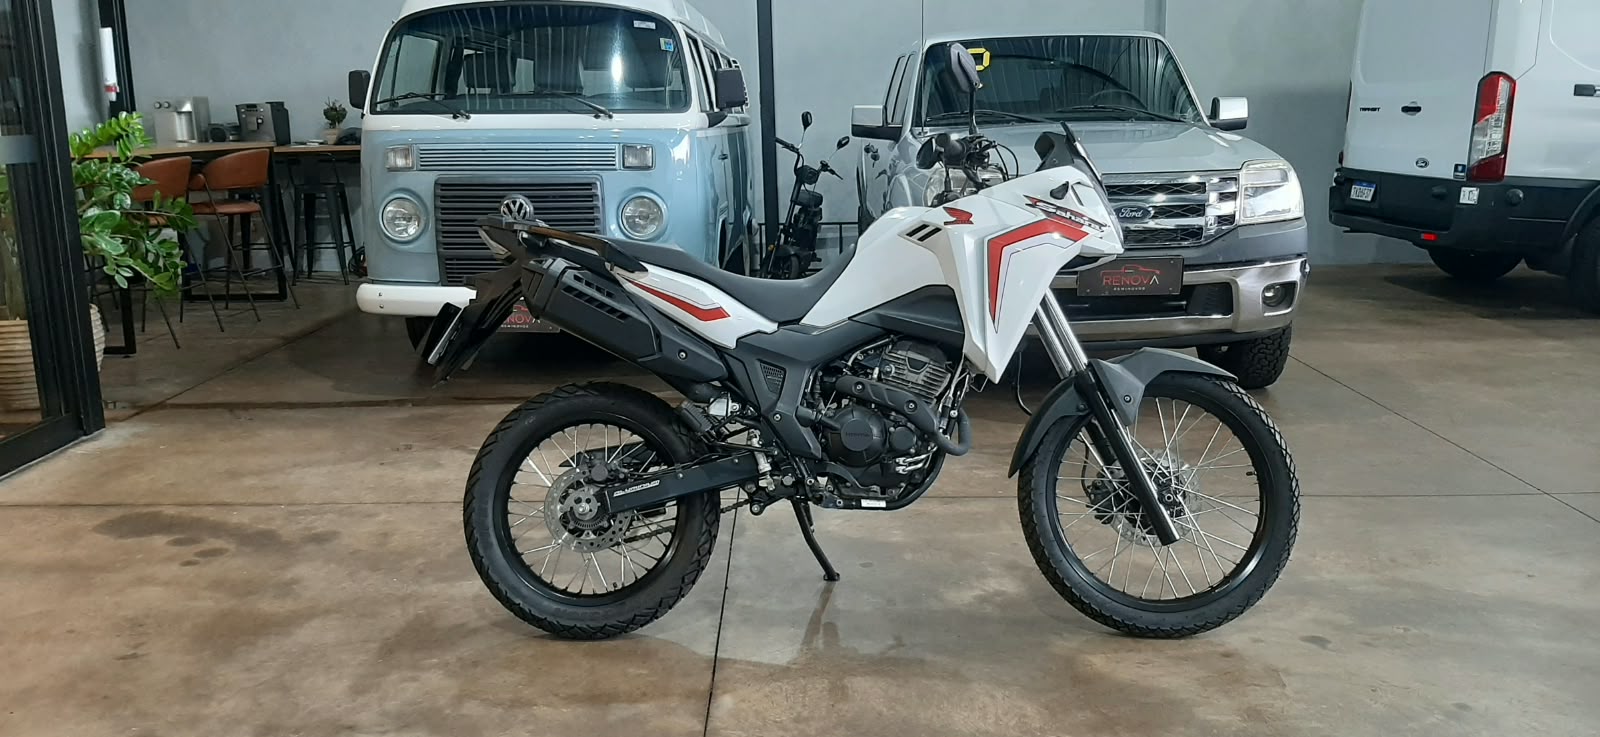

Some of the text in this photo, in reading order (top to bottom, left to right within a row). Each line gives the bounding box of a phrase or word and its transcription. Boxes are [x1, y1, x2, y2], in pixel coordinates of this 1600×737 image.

[1035, 200, 1109, 233] Sahara
[1119, 207, 1143, 218] Ford
[1103, 275, 1159, 286] RENOVA
